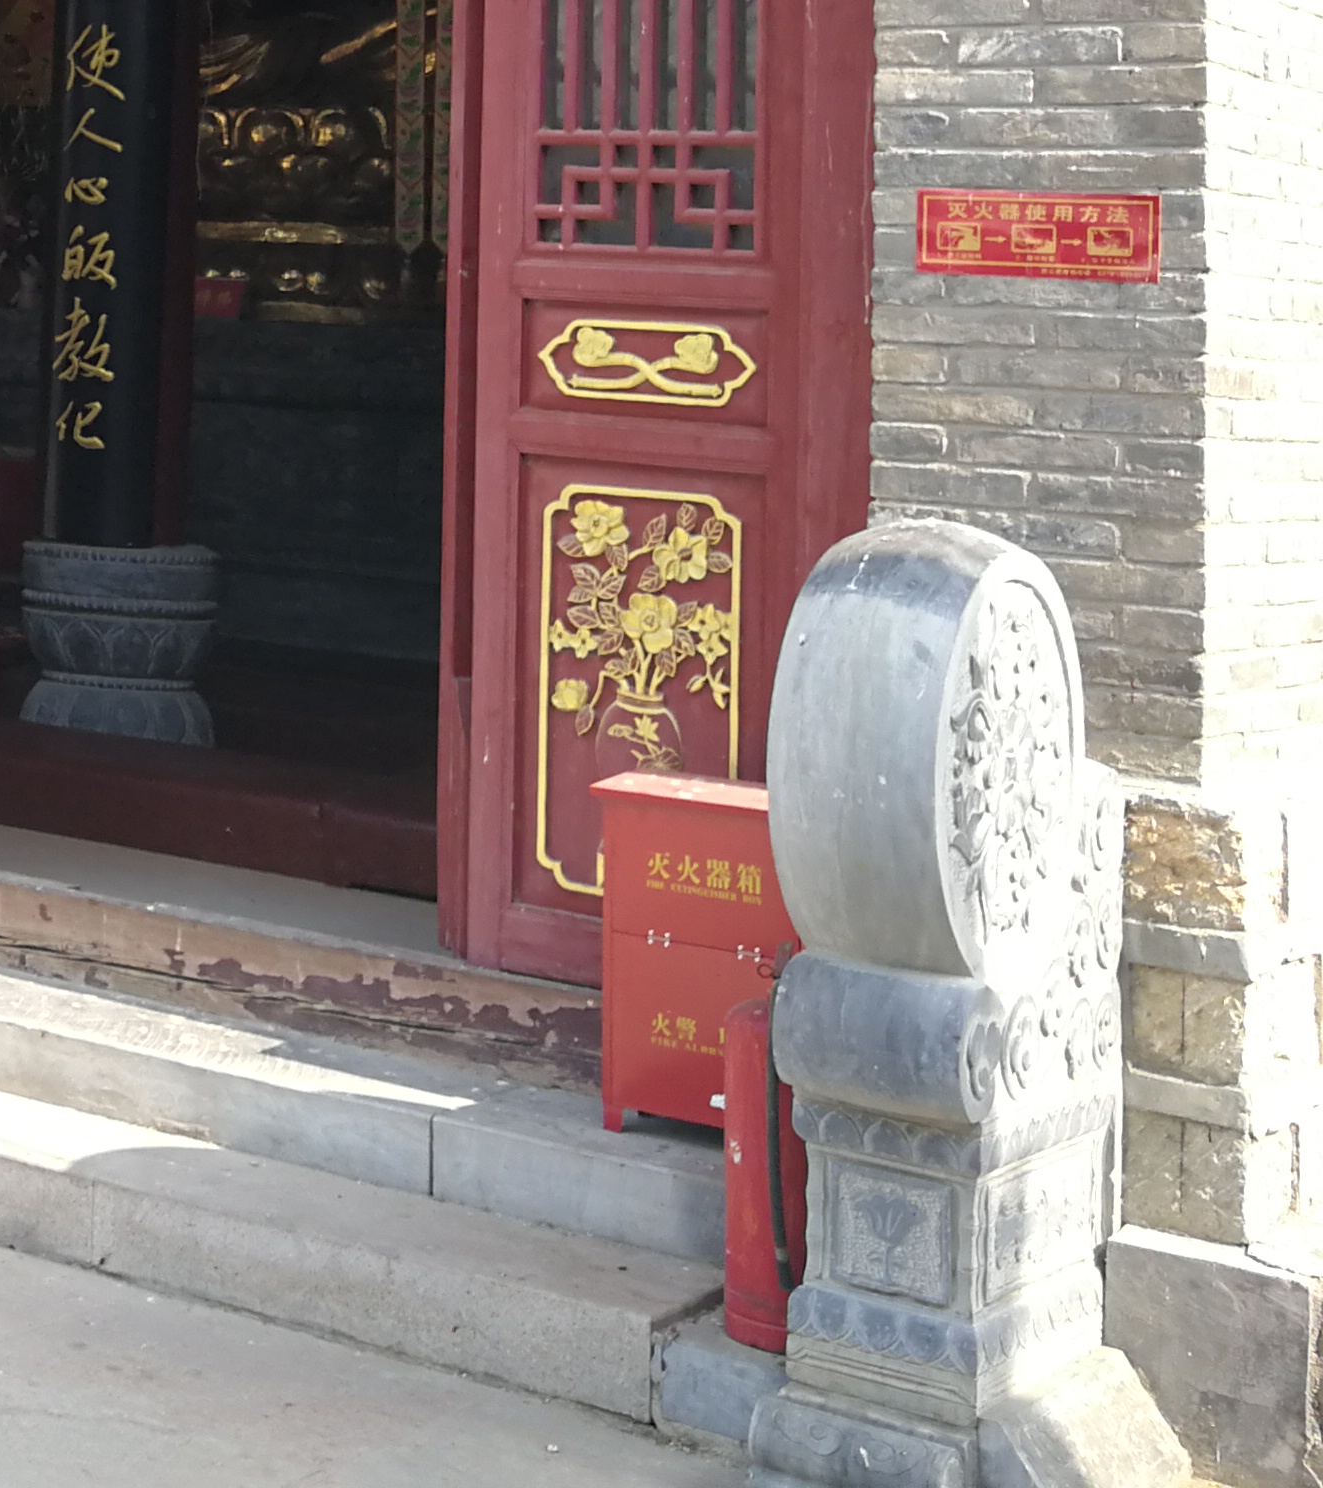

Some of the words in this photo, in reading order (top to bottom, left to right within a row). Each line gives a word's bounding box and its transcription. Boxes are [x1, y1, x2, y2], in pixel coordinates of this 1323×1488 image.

[947, 202, 1129, 223] 灭火器使用方法
[648, 852, 761, 896] 灭火器箱
